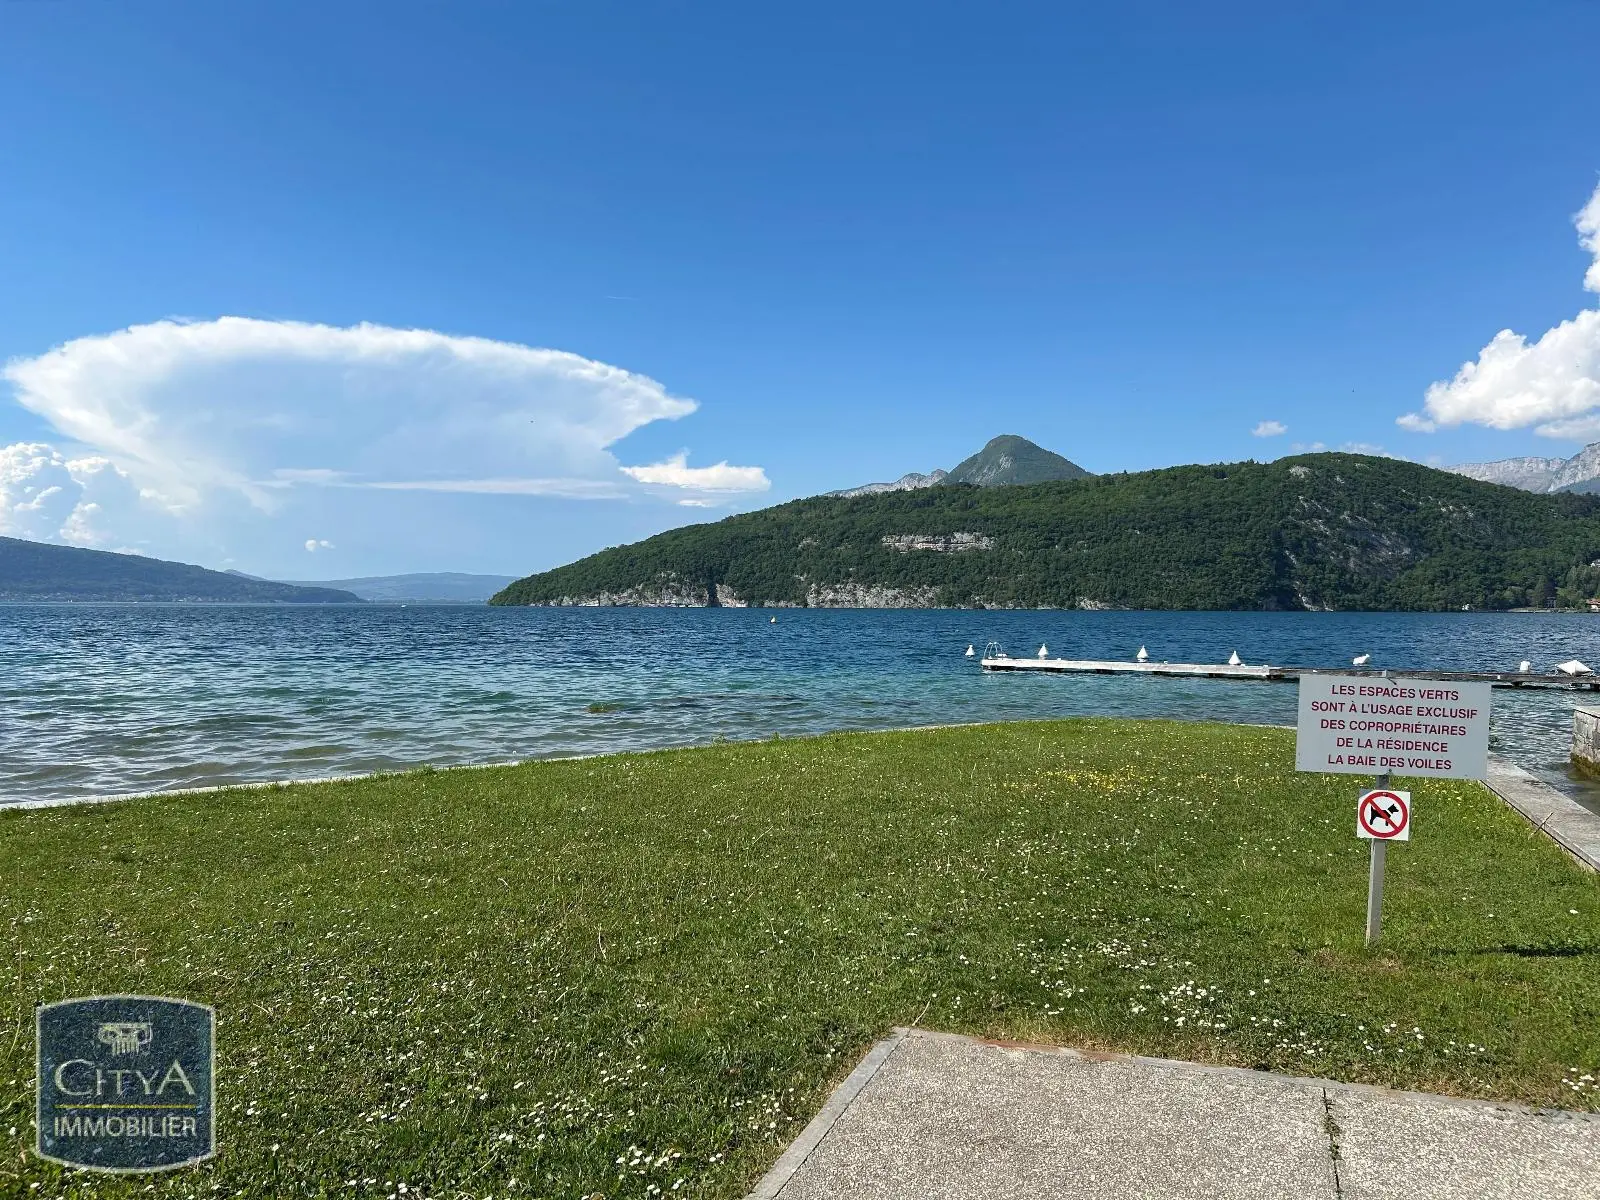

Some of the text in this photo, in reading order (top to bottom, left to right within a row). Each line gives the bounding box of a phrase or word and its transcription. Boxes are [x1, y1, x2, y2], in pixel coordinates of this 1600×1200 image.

[1331, 685, 1459, 700] LES ESPACES VERTS
[1312, 701, 1345, 712] SONT
[1349, 701, 1357, 713] À
[1417, 707, 1478, 718] EXCLUSIF
[1321, 719, 1466, 736] DES COPROPRIÉTAIRES
[1336, 737, 1448, 752] DE LA RÉSIDENCE
[1328, 754, 1452, 769] LA BAIE DES VOILES
